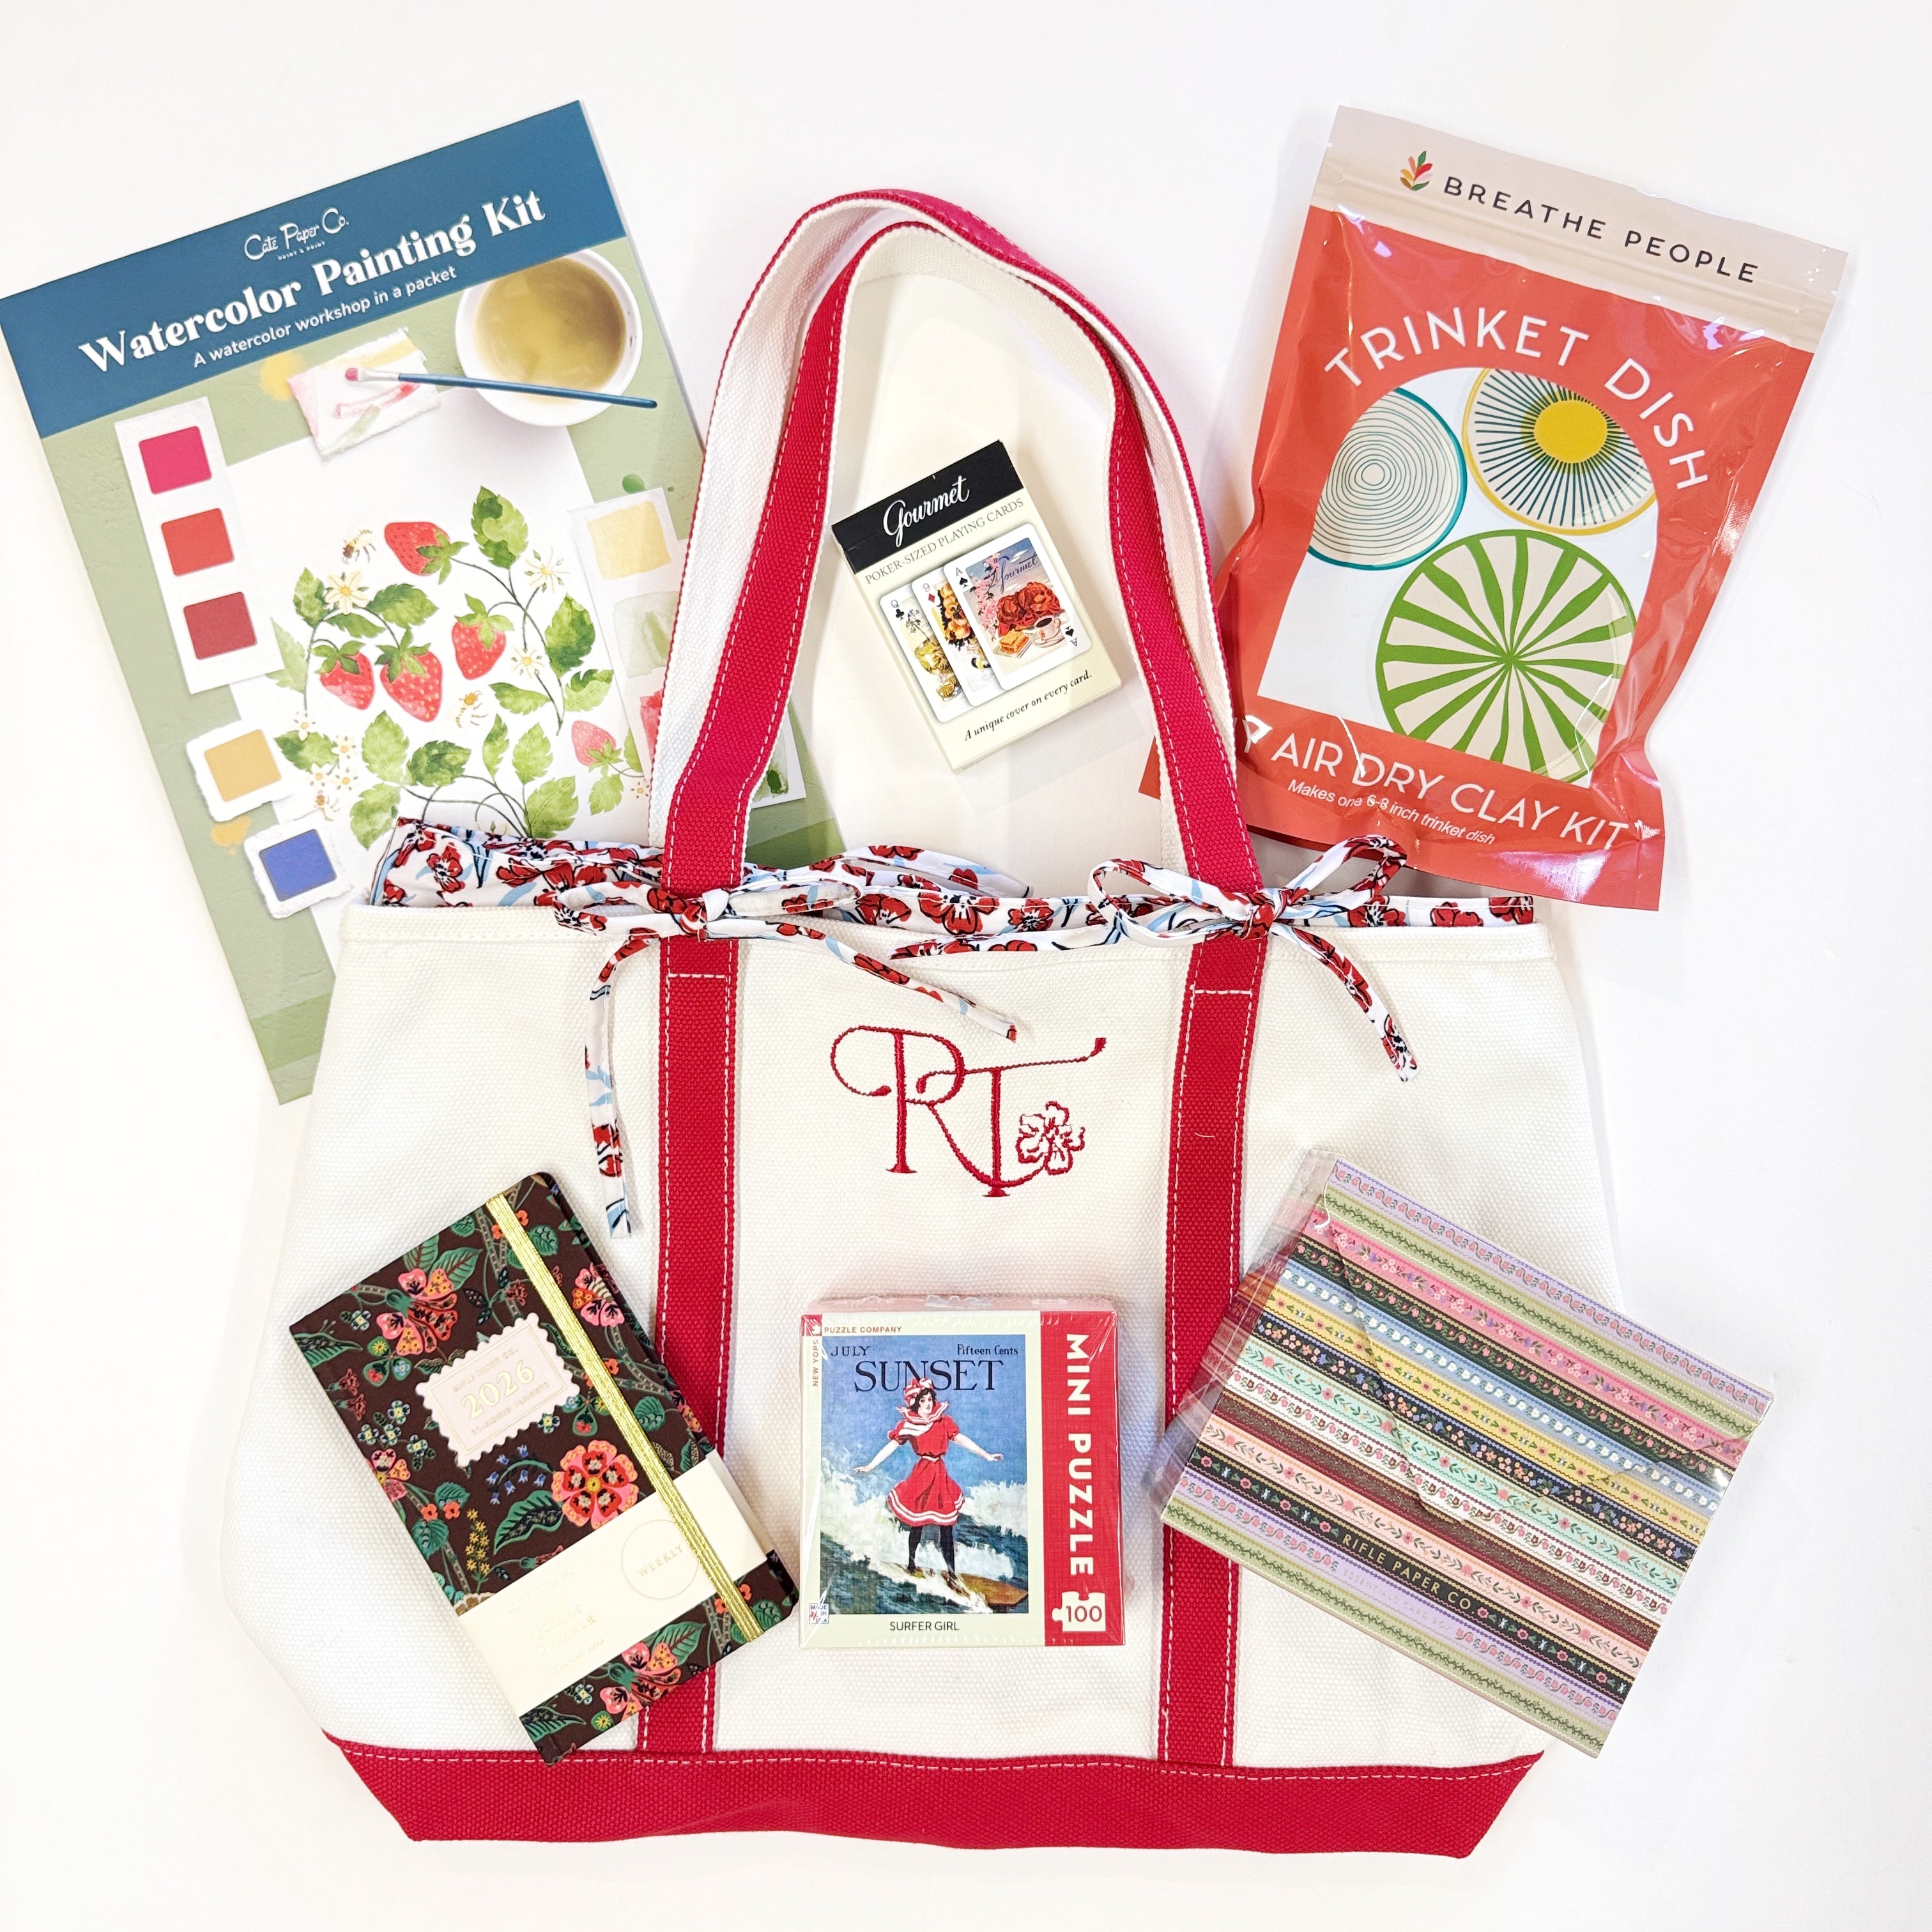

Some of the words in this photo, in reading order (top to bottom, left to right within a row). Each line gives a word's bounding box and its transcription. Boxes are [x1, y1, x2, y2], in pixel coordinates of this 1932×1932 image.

[244, 234, 279, 261] Cate
[279, 222, 319, 250] Paper
[322, 207, 349, 234] Co.
[1444, 176, 1608, 240] BREATHE
[1623, 230, 1759, 284] PEOPLE
[79, 280, 302, 373] Watercolor
[312, 215, 476, 296] Painting
[482, 190, 547, 236] Kit
[194, 353, 206, 367] A
[210, 325, 291, 362] watercolor
[295, 296, 371, 330] workshop
[374, 290, 388, 304] in
[392, 288, 402, 299] a
[406, 266, 457, 296] packet
[1324, 307, 1589, 388] TRINKET
[1604, 357, 1710, 490] DISH
[865, 543, 937, 585] POKER-SIZED
[938, 518, 986, 548] PLAYING
[987, 498, 1024, 524] CARDS
[883, 475, 969, 548] Gourmet
[891, 599, 900, 608] Q
[923, 583, 930, 592] 9
[956, 567, 964, 576] A
[964, 729, 972, 741] A
[974, 717, 1004, 736] unique
[1006, 702, 1029, 719] cover
[1031, 696, 1042, 707] on
[1044, 683, 1068, 700] every
[1070, 670, 1092, 687] card.
[1271, 733, 1343, 777] AIR
[1352, 752, 1444, 801] DRY
[1450, 783, 1560, 832] CLAY
[1560, 815, 1629, 850] KIT
[1287, 779, 1336, 802] Makes
[1337, 797, 1362, 807] one
[1366, 794, 1389, 810] 6-8
[1390, 801, 1420, 821] inch
[1420, 813, 1467, 838] trinket
[1466, 829, 1496, 845] dish
[831, 1346, 871, 1356] JULY
[957, 1344, 992, 1355] Fifteen
[993, 1344, 1019, 1356] Cents
[854, 1360, 1004, 1393] SUNSET
[1066, 1333, 1091, 1415] MINI
[462, 1360, 533, 1420] 2026
[1068, 1433, 1093, 1576] PUZZLE
[636, 1543, 684, 1577] WEEKLY
[1342, 1533, 1386, 1564] RIFLE
[1393, 1561, 1441, 1593] PAPER
[1448, 1591, 1476, 1614] CO.
[889, 1621, 933, 1631] SURFER
[935, 1621, 960, 1630] GIRL
[1066, 1606, 1103, 1623] 100
